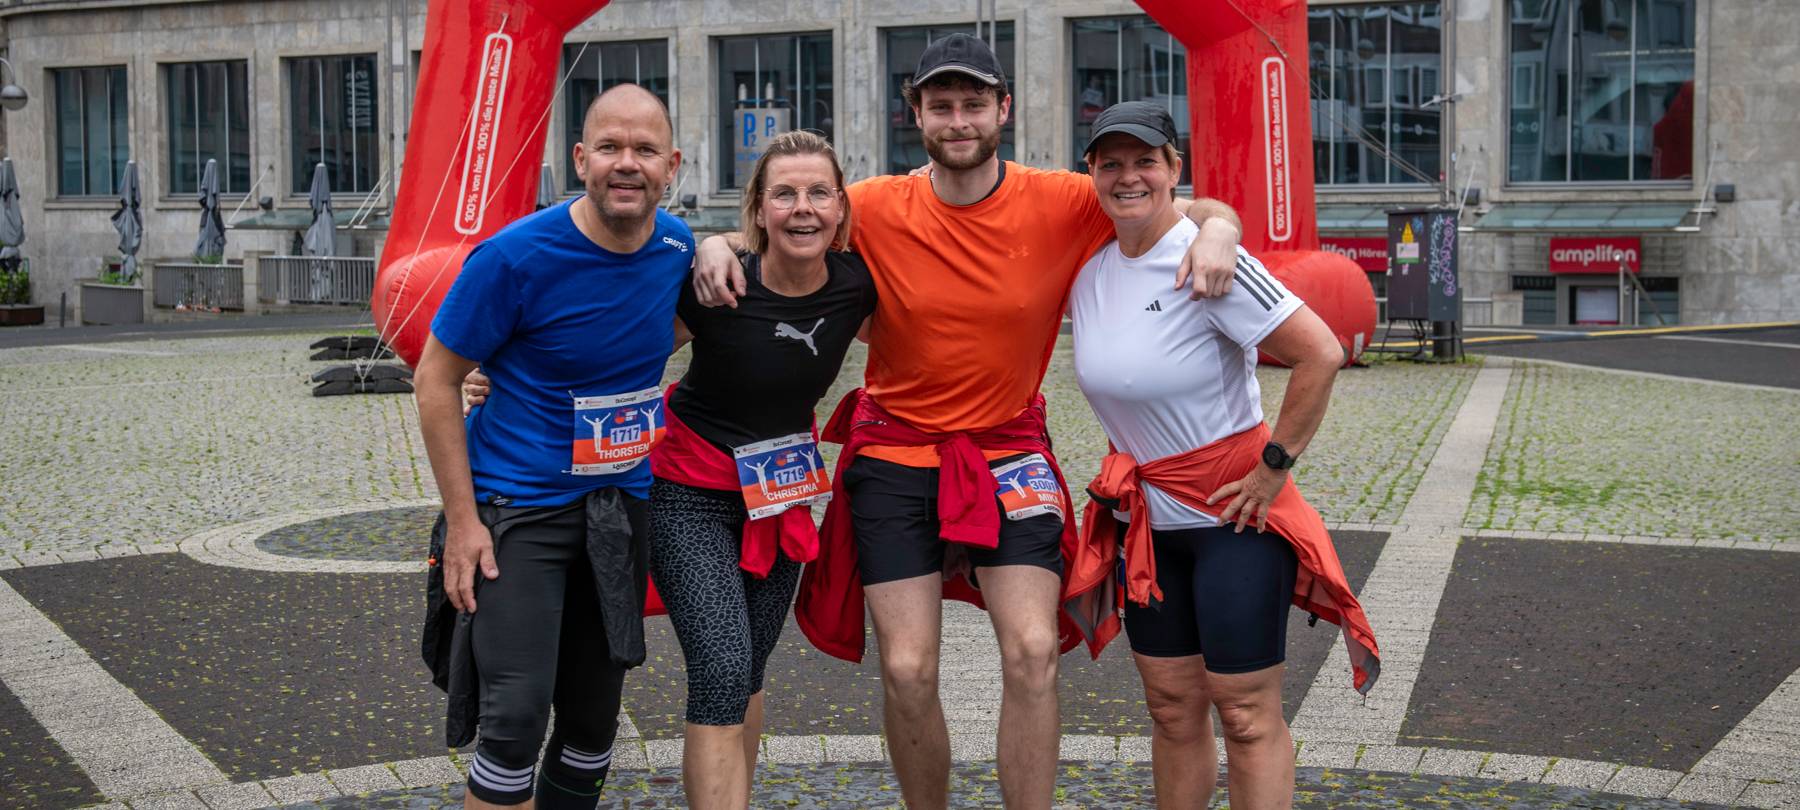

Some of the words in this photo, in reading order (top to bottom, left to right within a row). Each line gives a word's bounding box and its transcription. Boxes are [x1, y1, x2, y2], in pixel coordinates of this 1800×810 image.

[490, 46, 503, 77] Musik.
[485, 79, 497, 105] beste
[1270, 68, 1279, 98] Musik.
[483, 107, 493, 121] die
[1272, 99, 1280, 124] beste
[477, 122, 490, 151] 100%
[1272, 125, 1281, 138] die
[1273, 139, 1282, 165] 100%
[473, 153, 485, 173] hier.
[472, 175, 481, 191] von
[1275, 167, 1283, 186] hier.
[465, 194, 478, 223] 100%
[1276, 204, 1284, 231] 100%
[1552, 244, 1637, 266] amplifon
[612, 427, 640, 443] 1717
[599, 442, 650, 459] THORSTEN
[776, 467, 805, 485] 1719
[767, 482, 818, 501] CHRISTINA
